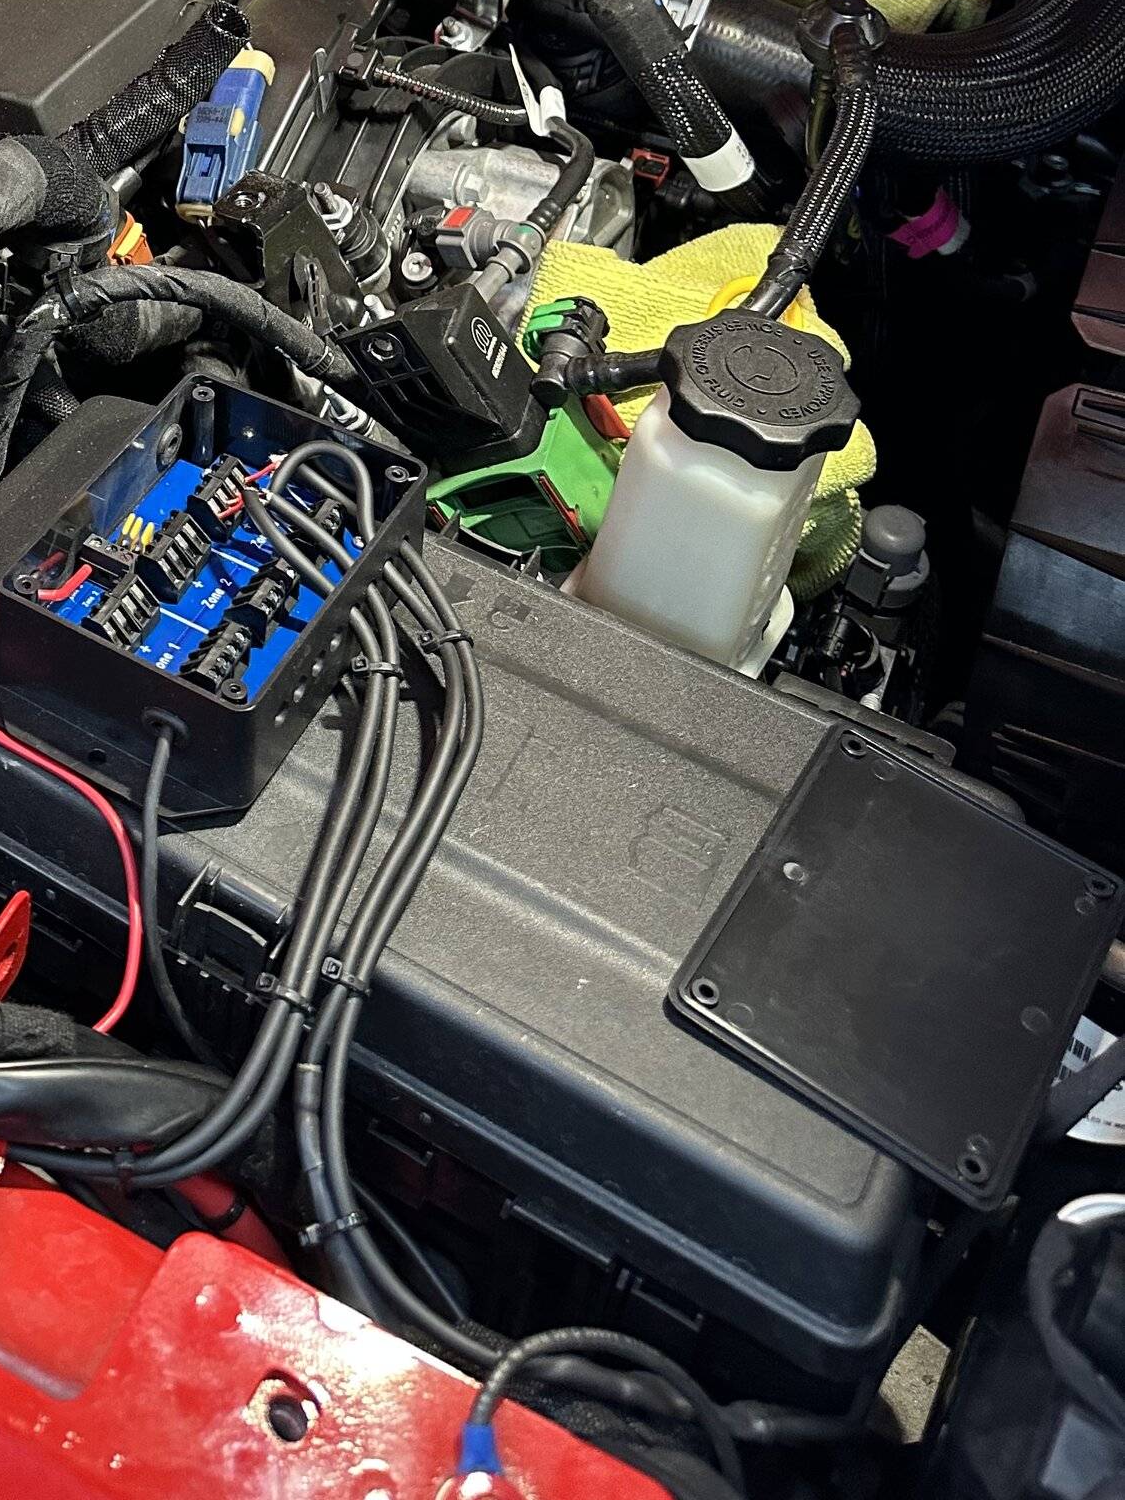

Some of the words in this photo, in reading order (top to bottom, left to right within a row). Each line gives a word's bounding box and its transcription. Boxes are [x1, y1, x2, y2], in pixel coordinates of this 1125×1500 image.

[723, 319, 784, 339] POWER
[692, 323, 725, 375] STEERING
[807, 349, 833, 374] USE
[703, 377, 746, 410] FLUID
[778, 373, 836, 420] APPROVED
[200, 586, 226, 610] Zone
[220, 577, 233, 588] 2
[155, 653, 175, 670] one
